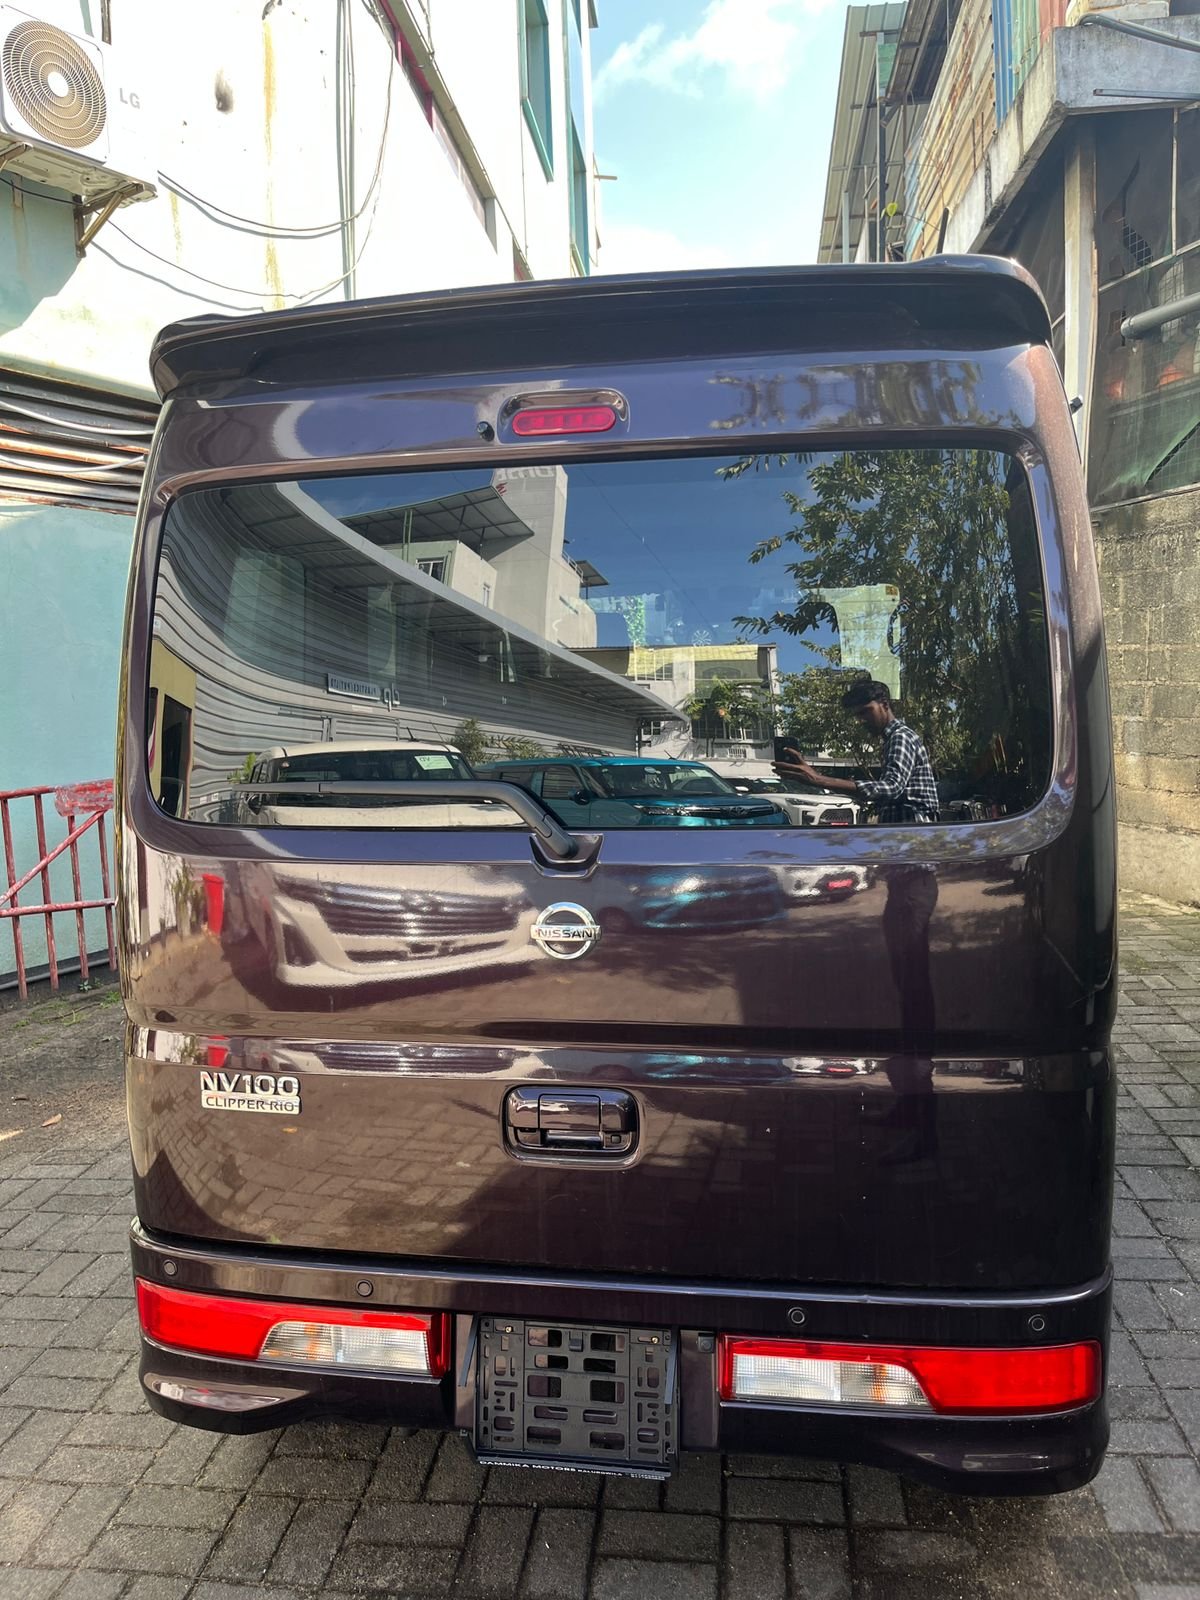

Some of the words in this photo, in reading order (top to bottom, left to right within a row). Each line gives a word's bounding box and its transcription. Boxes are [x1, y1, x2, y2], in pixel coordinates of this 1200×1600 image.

[119, 87, 140, 109] LG
[537, 928, 593, 938] NISSAN
[200, 1071, 299, 1096] NV100
[206, 1096, 265, 1110] CLIPPER
[269, 1101, 294, 1112] RIO
